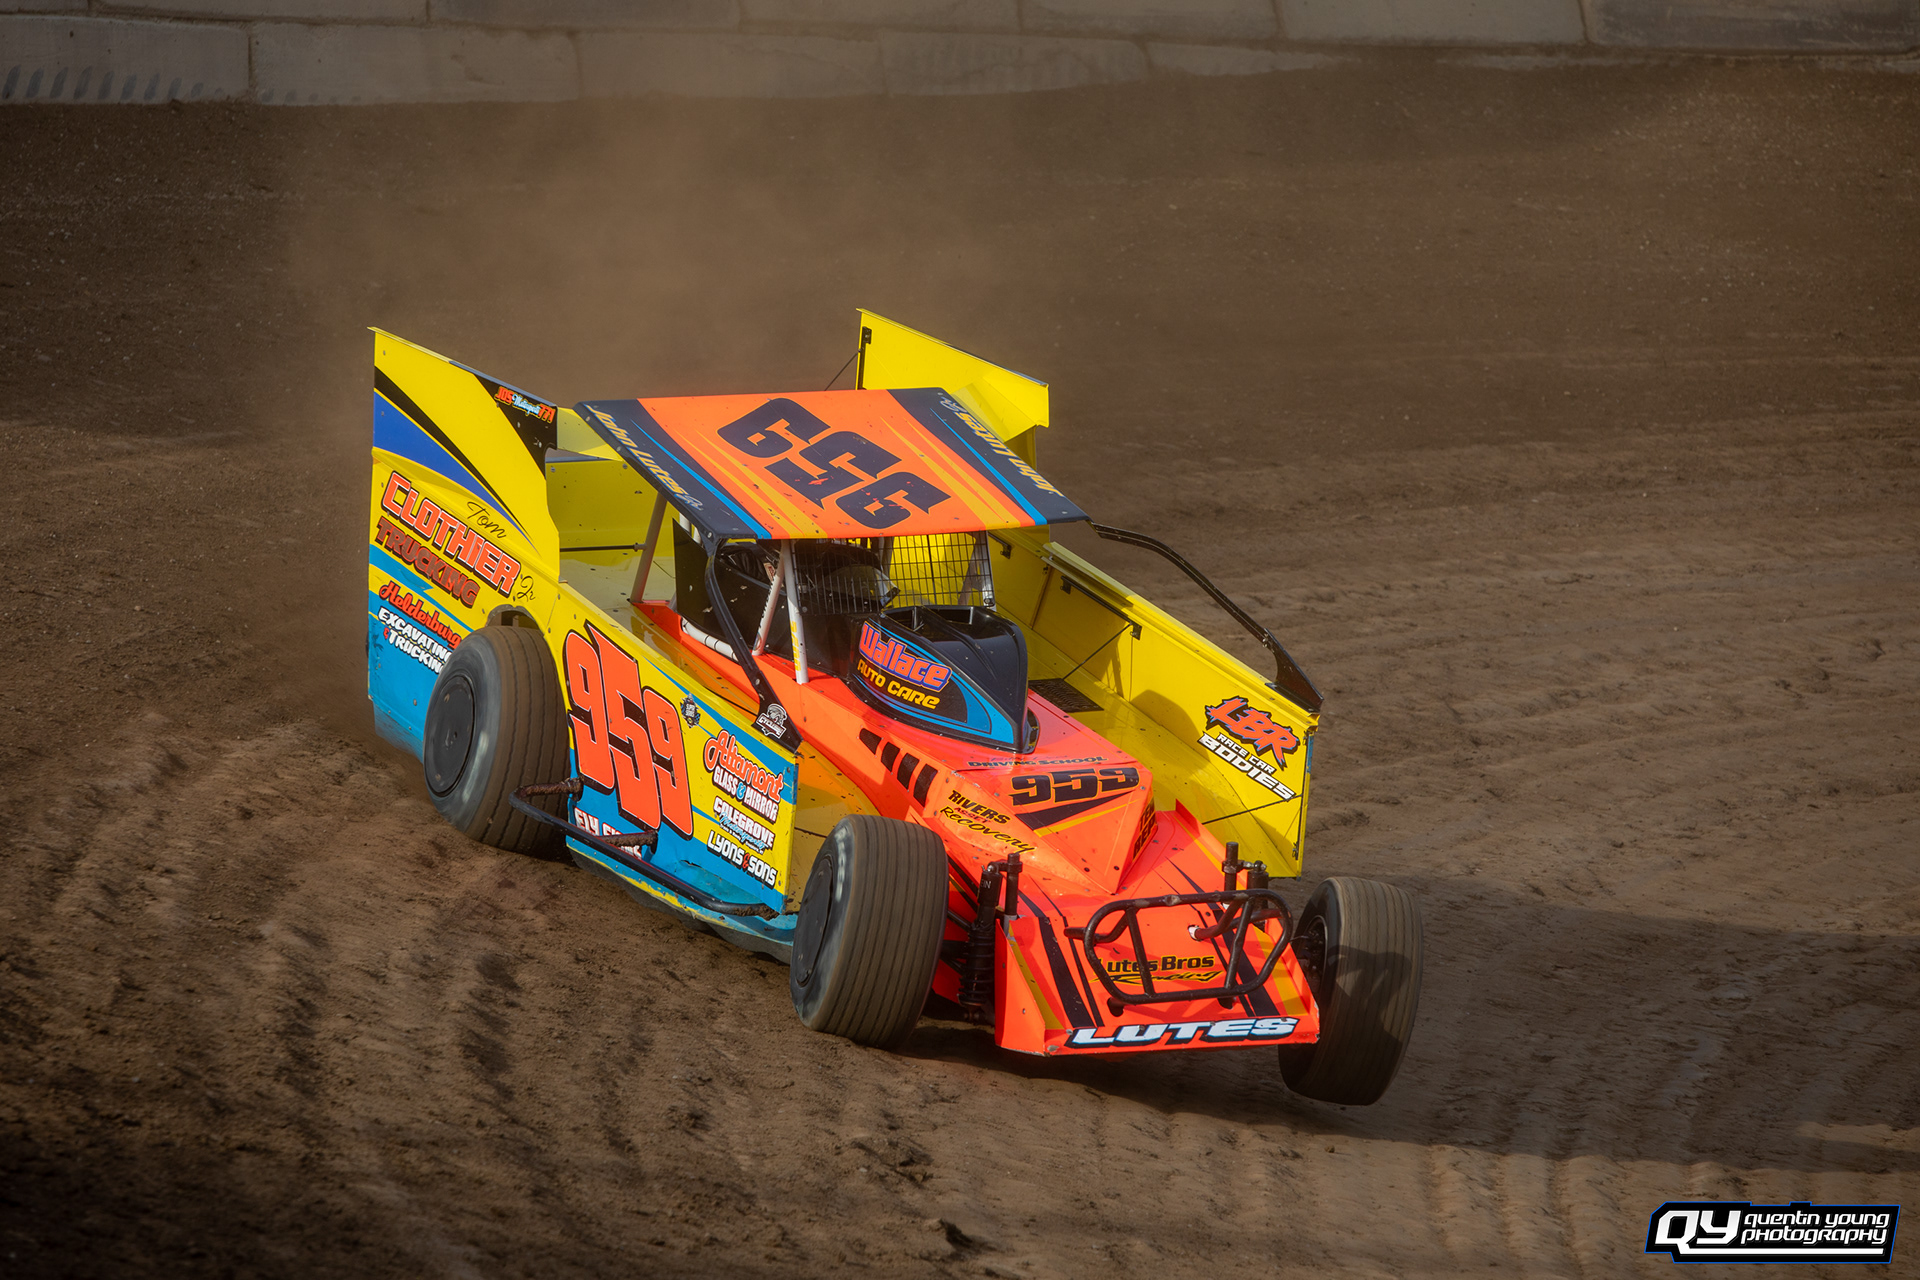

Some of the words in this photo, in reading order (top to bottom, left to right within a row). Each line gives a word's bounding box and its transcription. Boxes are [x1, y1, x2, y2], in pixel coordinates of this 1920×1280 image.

[584, 404, 638, 448] John
[629, 448, 690, 496] Lutes
[954, 411, 1018, 458] Lutes
[717, 397, 951, 530] 959
[1008, 457, 1065, 497] John
[381, 471, 521, 598] CLOTHIER
[467, 501, 506, 539] Tom
[375, 516, 480, 608] TRUCKING
[379, 580, 461, 650] Helderburg
[388, 629, 444, 674] TRUCKIN
[859, 621, 952, 692] Wallace
[857, 658, 886, 687] AUTO
[887, 680, 940, 709] CARE
[564, 621, 693, 839] 959
[1216, 732, 1250, 757] RACE
[1248, 754, 1277, 774] CAR
[703, 729, 784, 803] Altamont
[967, 760, 1037, 768] DRIVING
[1037, 756, 1107, 766] SCHOOL
[1008, 766, 1140, 807] 959
[1197, 731, 1296, 801] BODIES
[713, 765, 739, 797] GLASS
[743, 785, 779, 823] MIRROR
[947, 789, 1011, 824] RIVERS
[713, 796, 775, 849] COLEGROVE
[939, 806, 1036, 855] Recovery
[707, 830, 745, 867] LYONS
[742, 853, 750, 870] &
[747, 854, 778, 889] SONS
[1096, 958, 1158, 974] utes
[1161, 956, 1214, 971] Bros
[1065, 1016, 1299, 1048] LUTES
